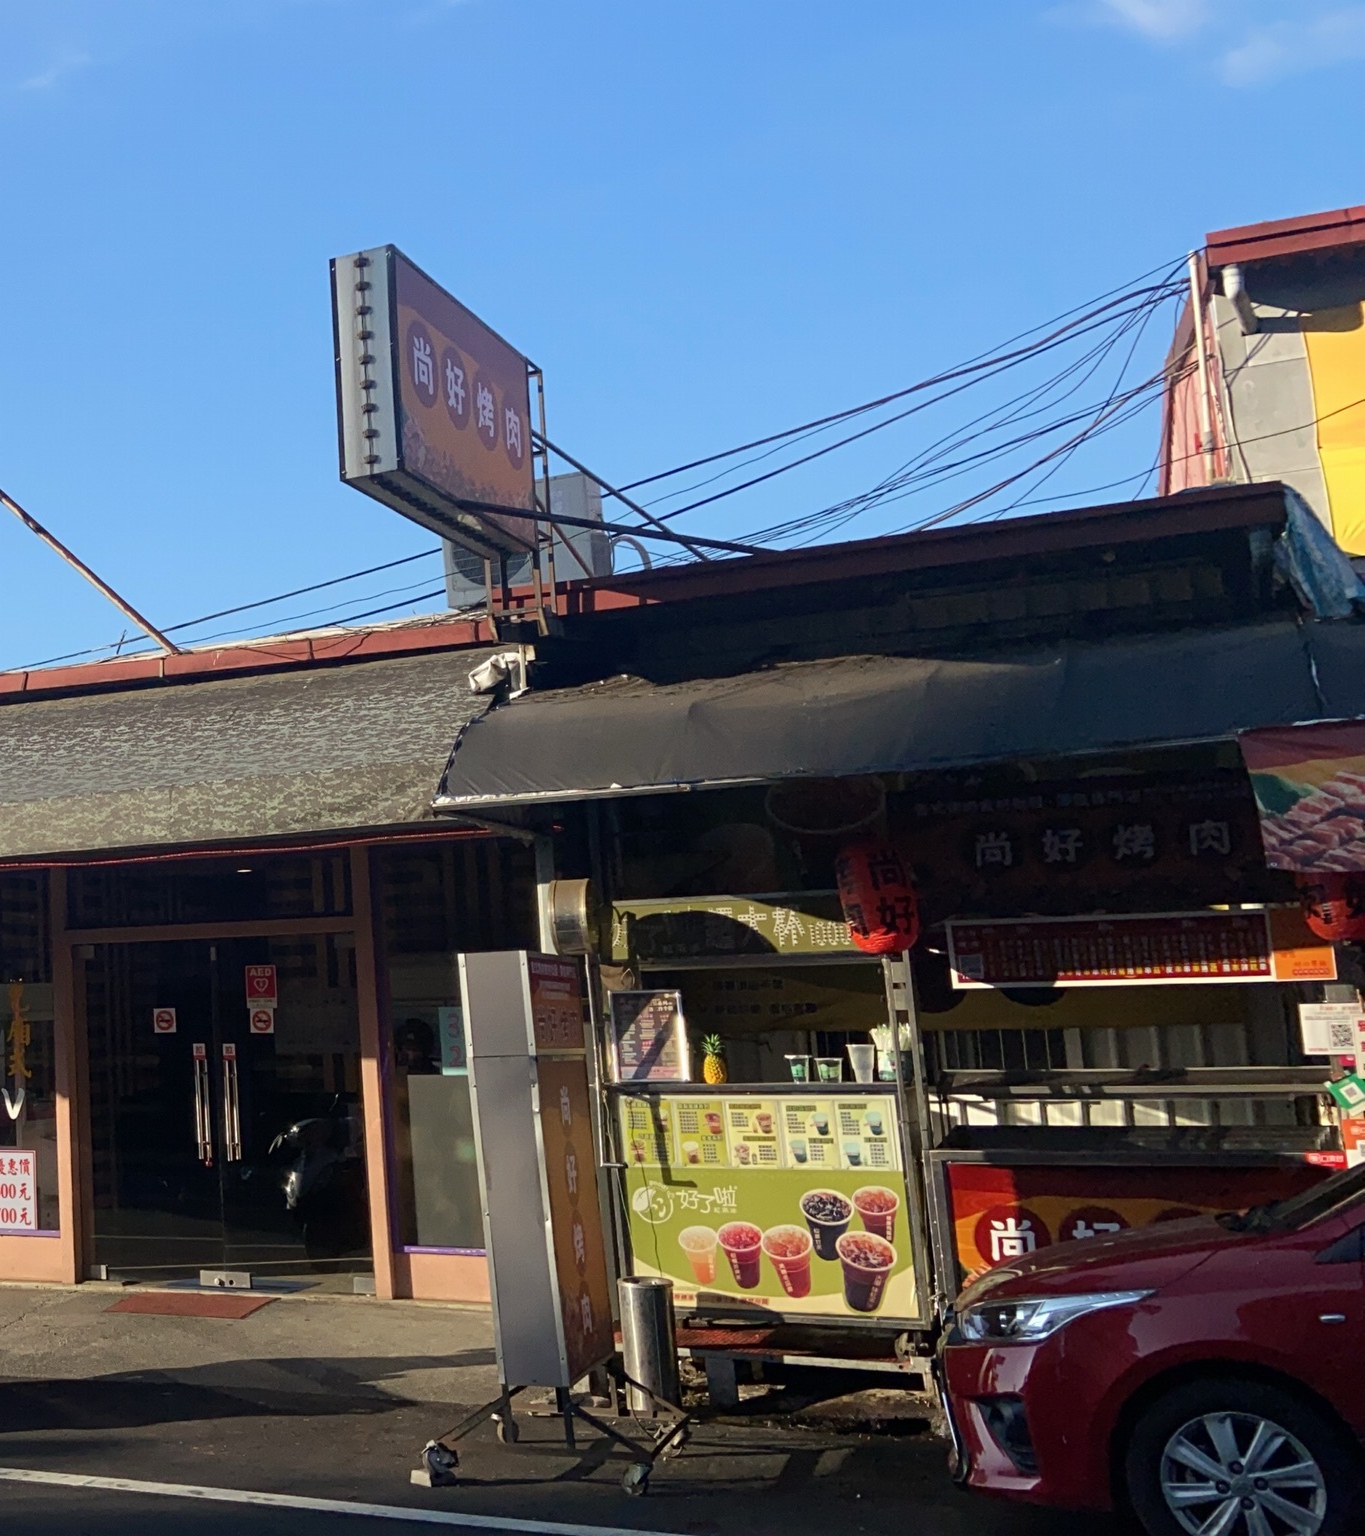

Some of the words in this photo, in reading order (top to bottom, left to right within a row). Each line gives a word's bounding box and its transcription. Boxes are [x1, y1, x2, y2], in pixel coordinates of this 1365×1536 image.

[412, 335, 522, 459] 尚好烤肉
[974, 818, 1233, 868] 尚好烤肉
[249, 968, 272, 977] AED
[559, 1084, 593, 1336] 尚好烤肉
[675, 1184, 738, 1214] 好了啦
